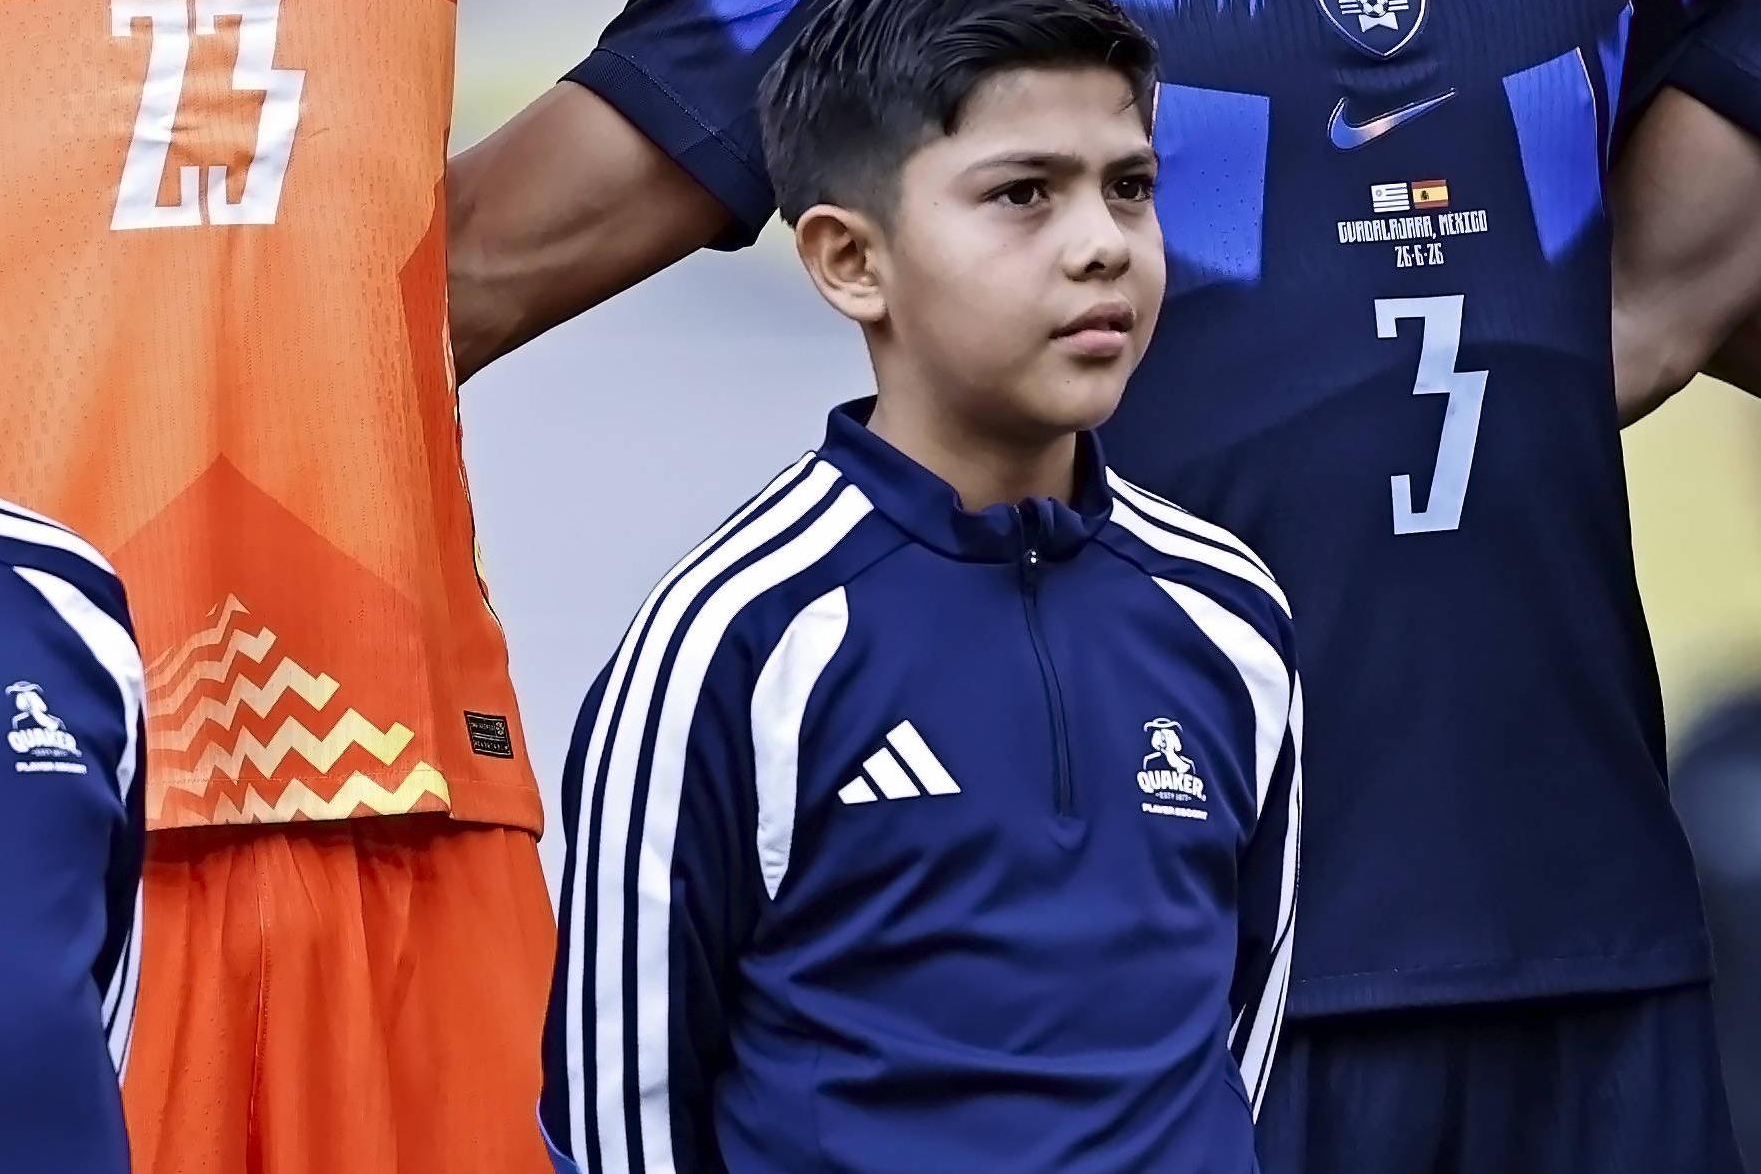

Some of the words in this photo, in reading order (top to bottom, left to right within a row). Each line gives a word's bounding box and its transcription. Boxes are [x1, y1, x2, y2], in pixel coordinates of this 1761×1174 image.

[1337, 215, 1437, 244] GUADALAJARA,
[1374, 294, 1490, 535] 3
[1137, 769, 1205, 799] QUAKER
